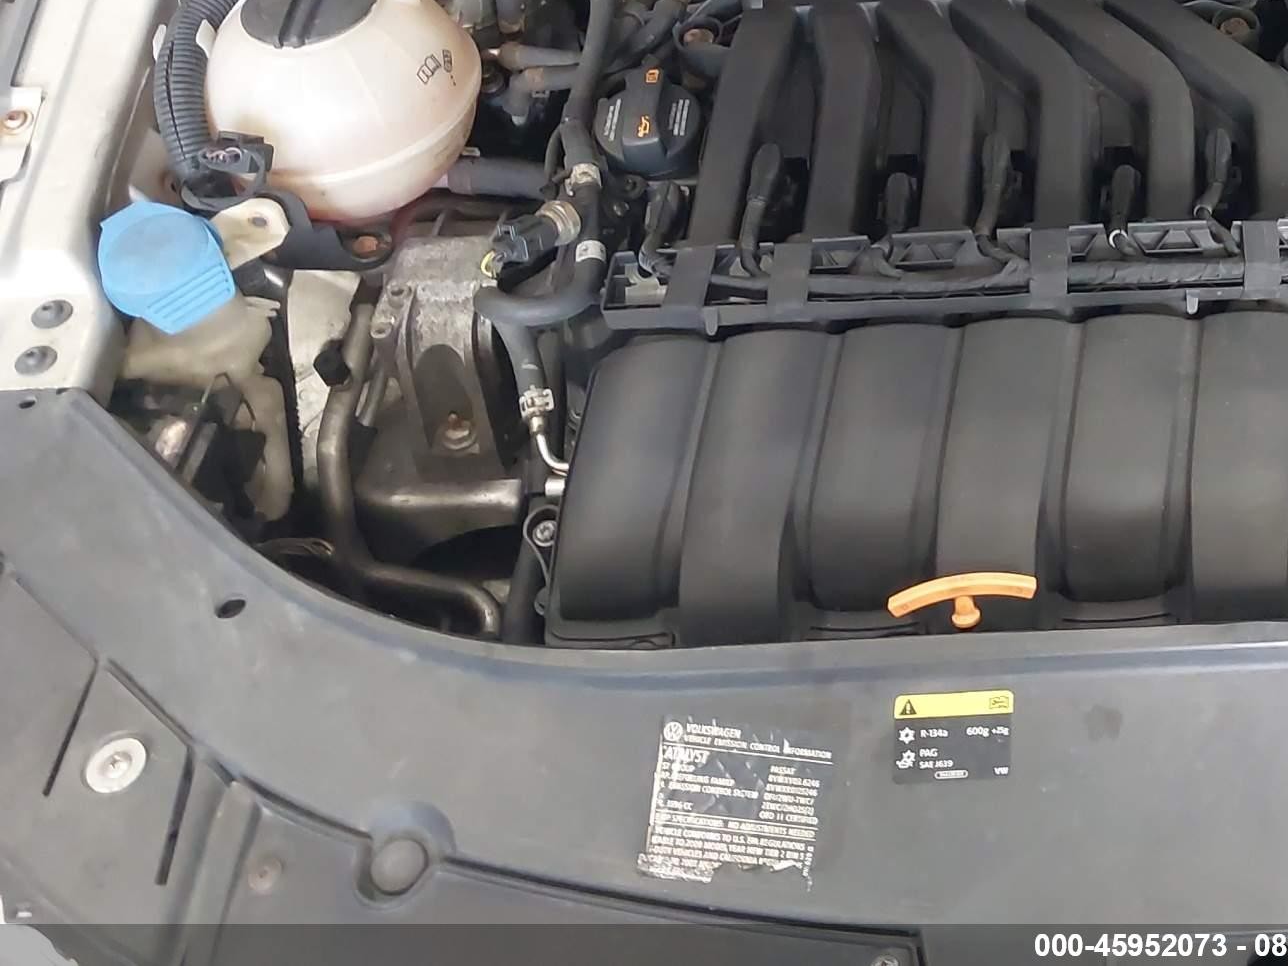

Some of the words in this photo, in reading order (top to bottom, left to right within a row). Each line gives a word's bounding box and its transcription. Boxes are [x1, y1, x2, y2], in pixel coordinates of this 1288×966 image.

[750, 742, 780, 753] CONTROL
[919, 749, 938, 757] PAG
[722, 834, 731, 842] TO
[781, 850, 785, 858] 2
